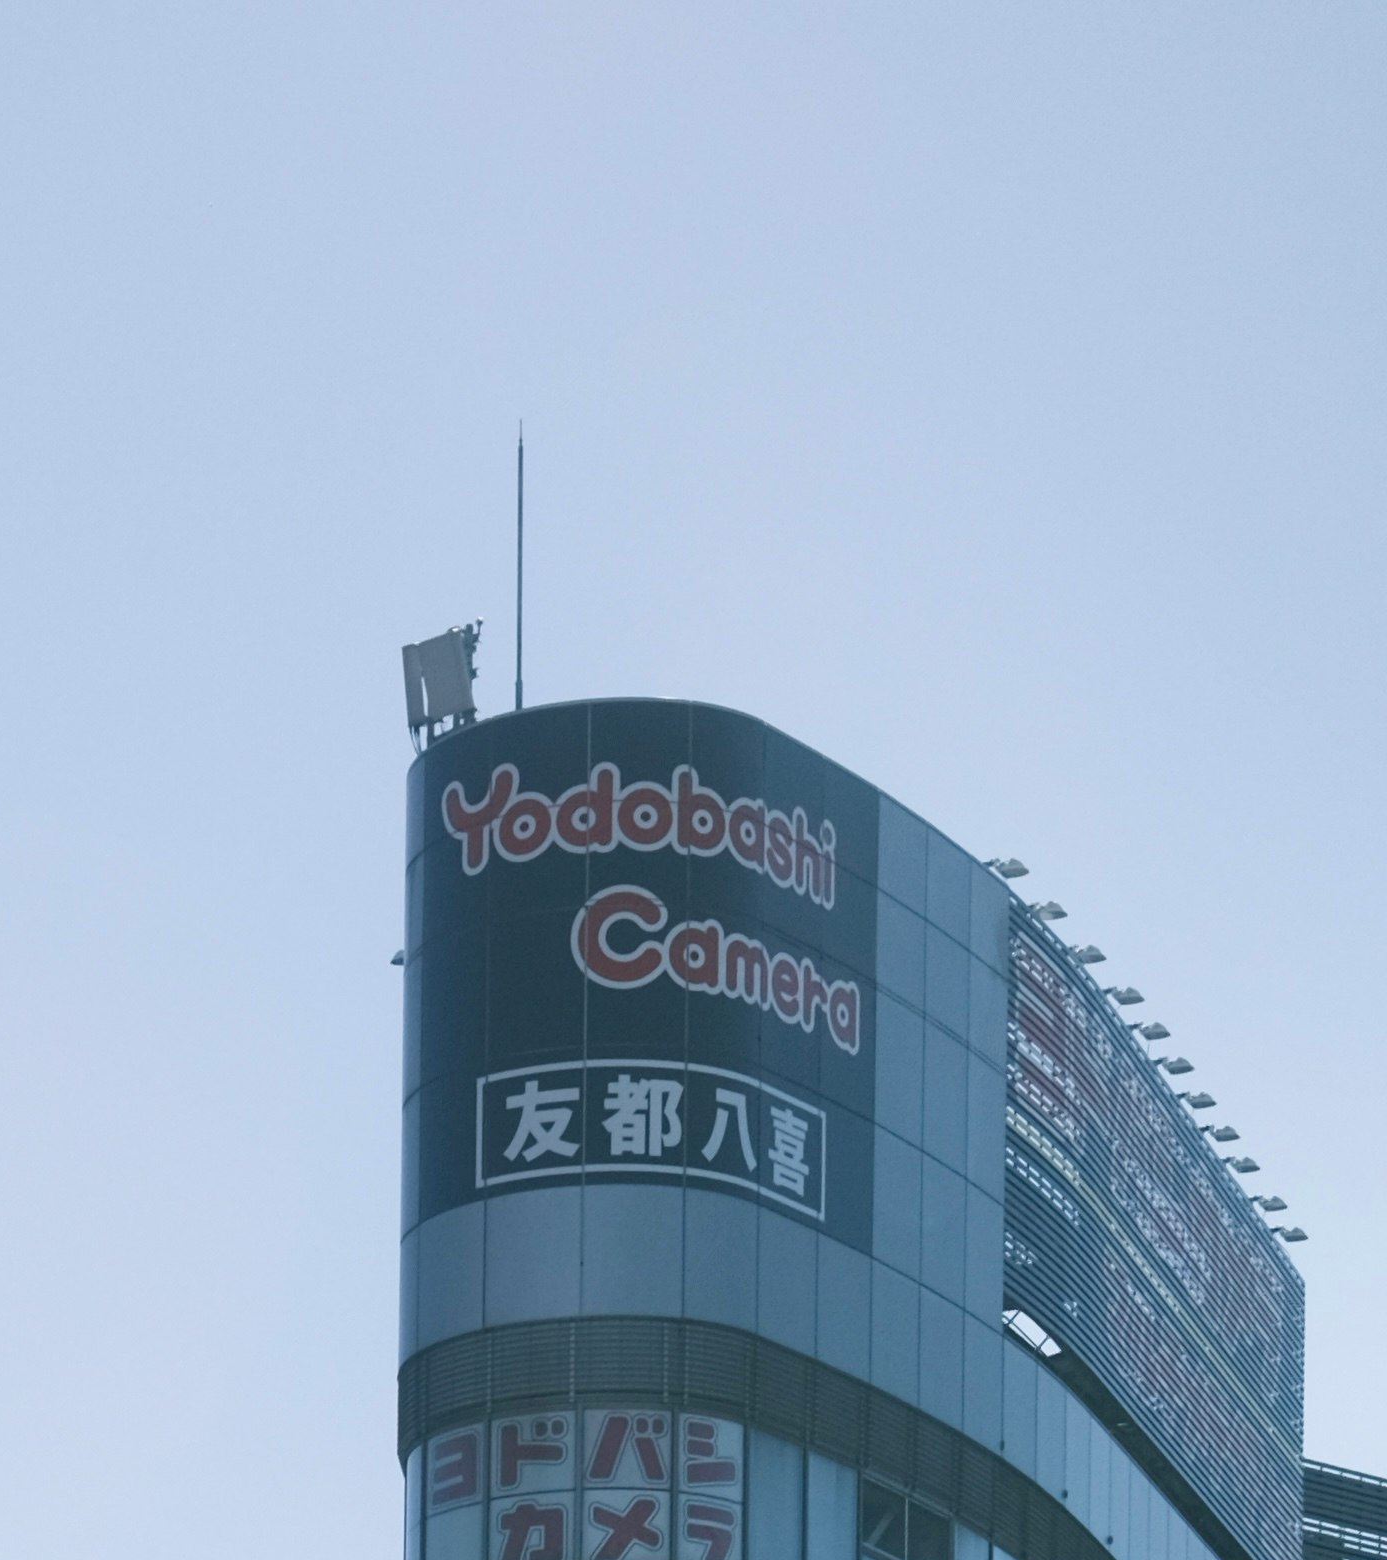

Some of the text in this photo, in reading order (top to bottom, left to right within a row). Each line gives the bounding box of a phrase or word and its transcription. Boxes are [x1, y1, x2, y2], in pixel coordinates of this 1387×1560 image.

[442, 762, 836, 910] Yodobashi
[570, 884, 860, 1056] Camera
[503, 1074, 811, 1197] 友都八喜
[431, 1414, 739, 1511] ヨドバシ
